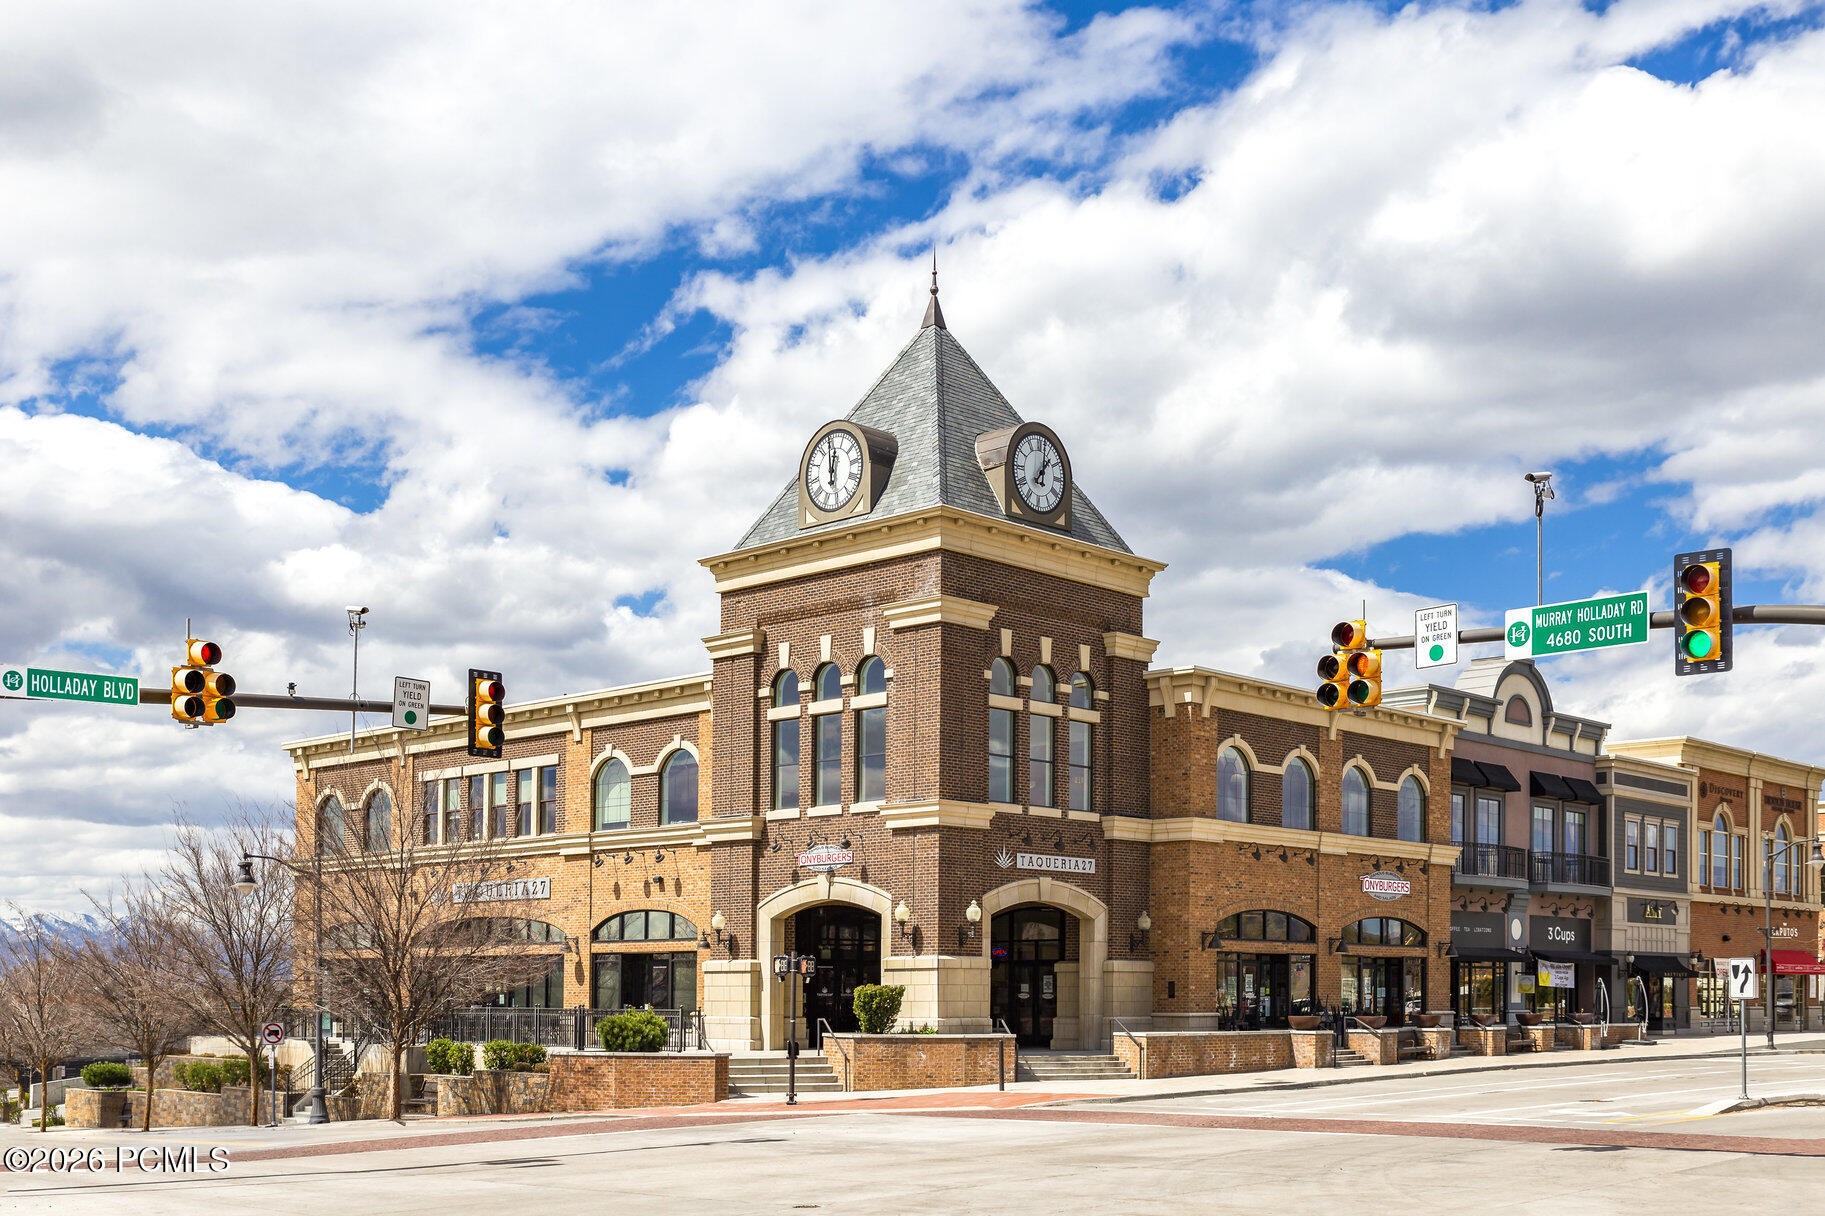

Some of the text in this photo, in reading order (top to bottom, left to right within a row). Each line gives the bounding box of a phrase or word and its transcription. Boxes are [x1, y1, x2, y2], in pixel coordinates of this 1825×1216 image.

[1420, 609, 1453, 621] LEFT TURN
[1535, 599, 1644, 629] MURRAY HOLLADAY RD
[1425, 620, 1448, 632] YIELD
[1421, 632, 1452, 644] ON GREEN
[1546, 622, 1632, 648] 4680 SOUTH
[31, 673, 134, 700] HOLLADAY BLVD
[399, 681, 426, 691] LEFT TURN
[402, 690, 422, 701] YIELD
[408, 701, 424, 709] GREEN
[795, 851, 852, 866] TONYBURGERS
[1020, 855, 1093, 872] TAQUERIA27
[1359, 875, 1410, 893] TONYBURGERS
[1547, 926, 1576, 944] 3 Cups
